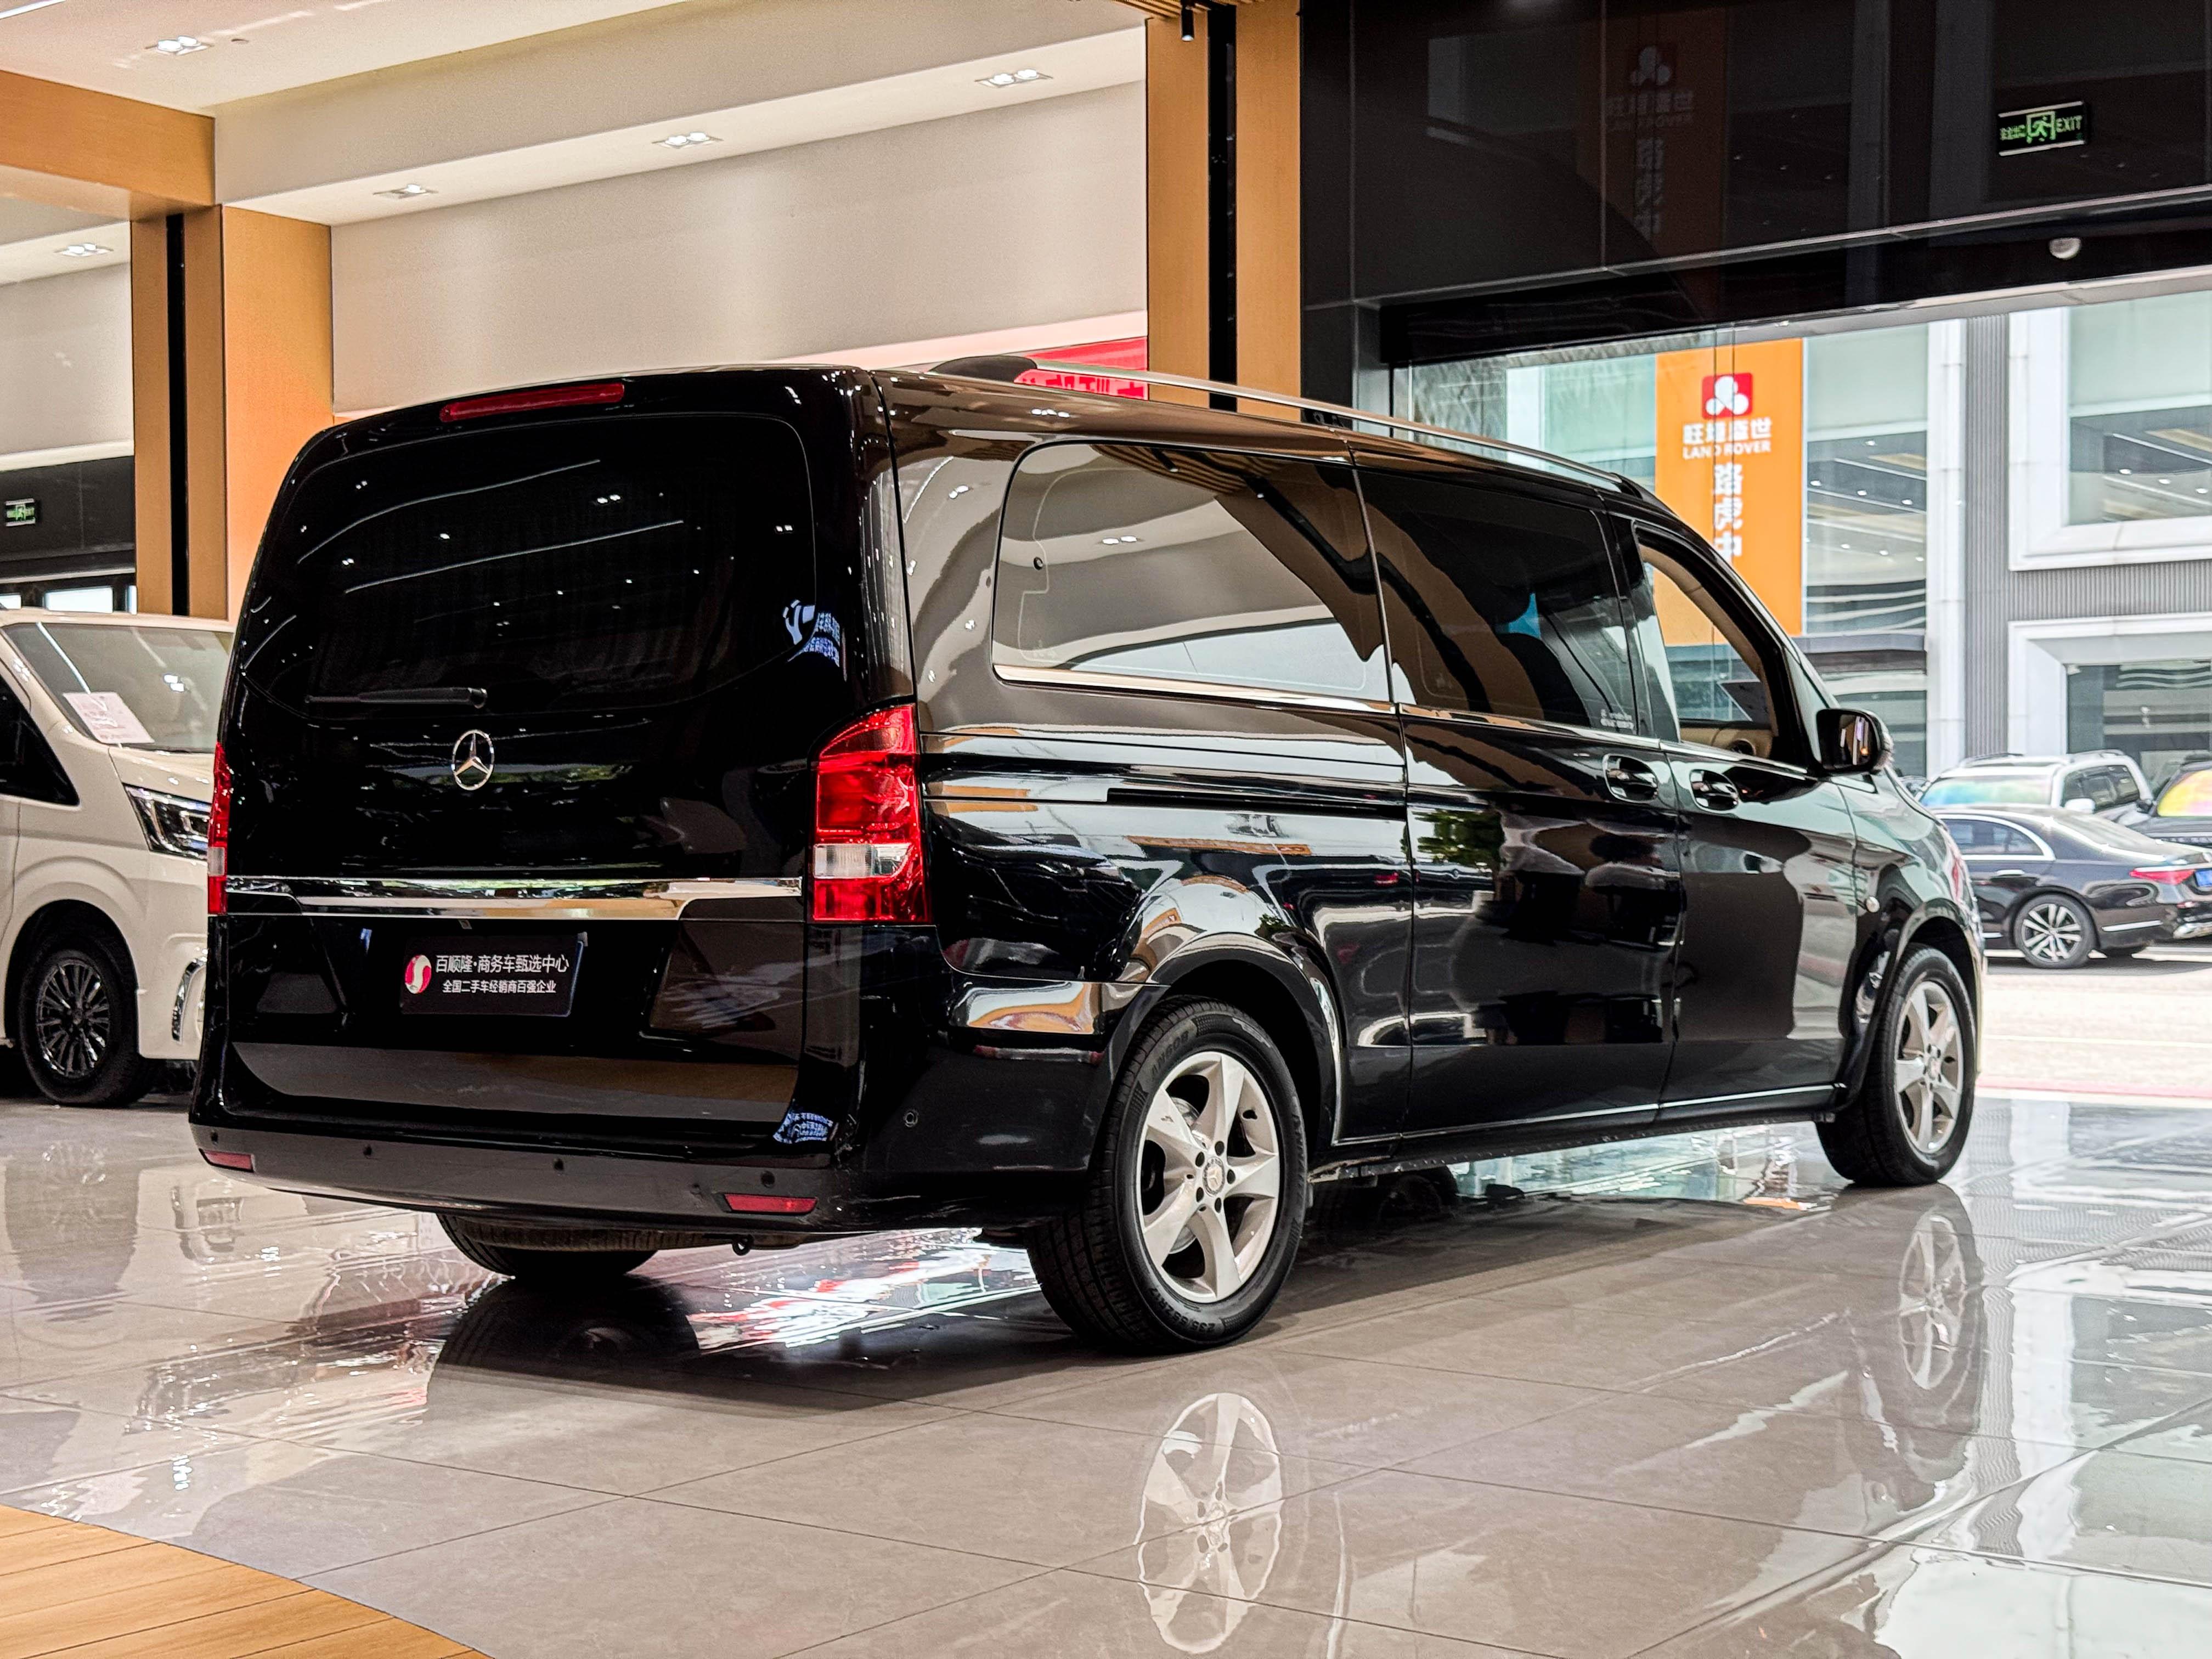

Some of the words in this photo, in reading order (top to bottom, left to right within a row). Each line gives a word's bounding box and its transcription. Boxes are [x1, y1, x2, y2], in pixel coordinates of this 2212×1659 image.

[2056, 115, 2083, 133] EXIT
[1683, 445, 1722, 460] LAND
[1724, 440, 1771, 457] ROVER
[436, 954, 569, 973] 百顺隆·商务车甄选中心
[442, 979, 556, 994] 全国二手车经销商百强企业
